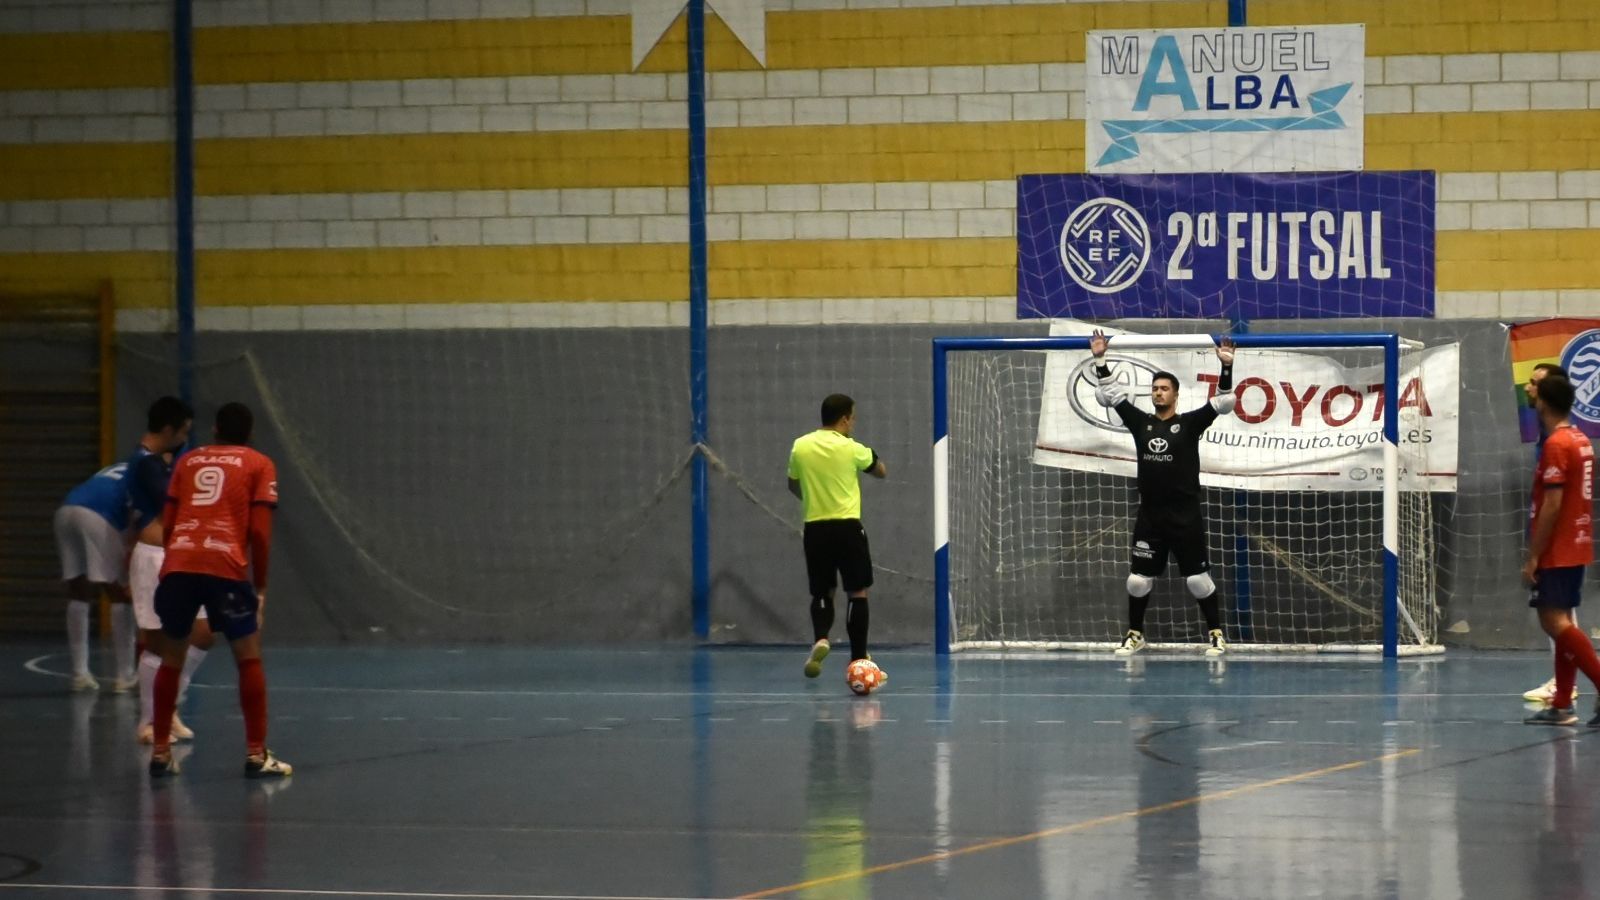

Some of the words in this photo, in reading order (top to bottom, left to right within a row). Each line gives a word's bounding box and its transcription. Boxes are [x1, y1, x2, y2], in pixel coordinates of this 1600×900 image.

[1227, 210, 1391, 280] FUTSAL
[1199, 428, 1433, 450] ww.nimauto.toyot.es
[191, 466, 225, 506] 9
